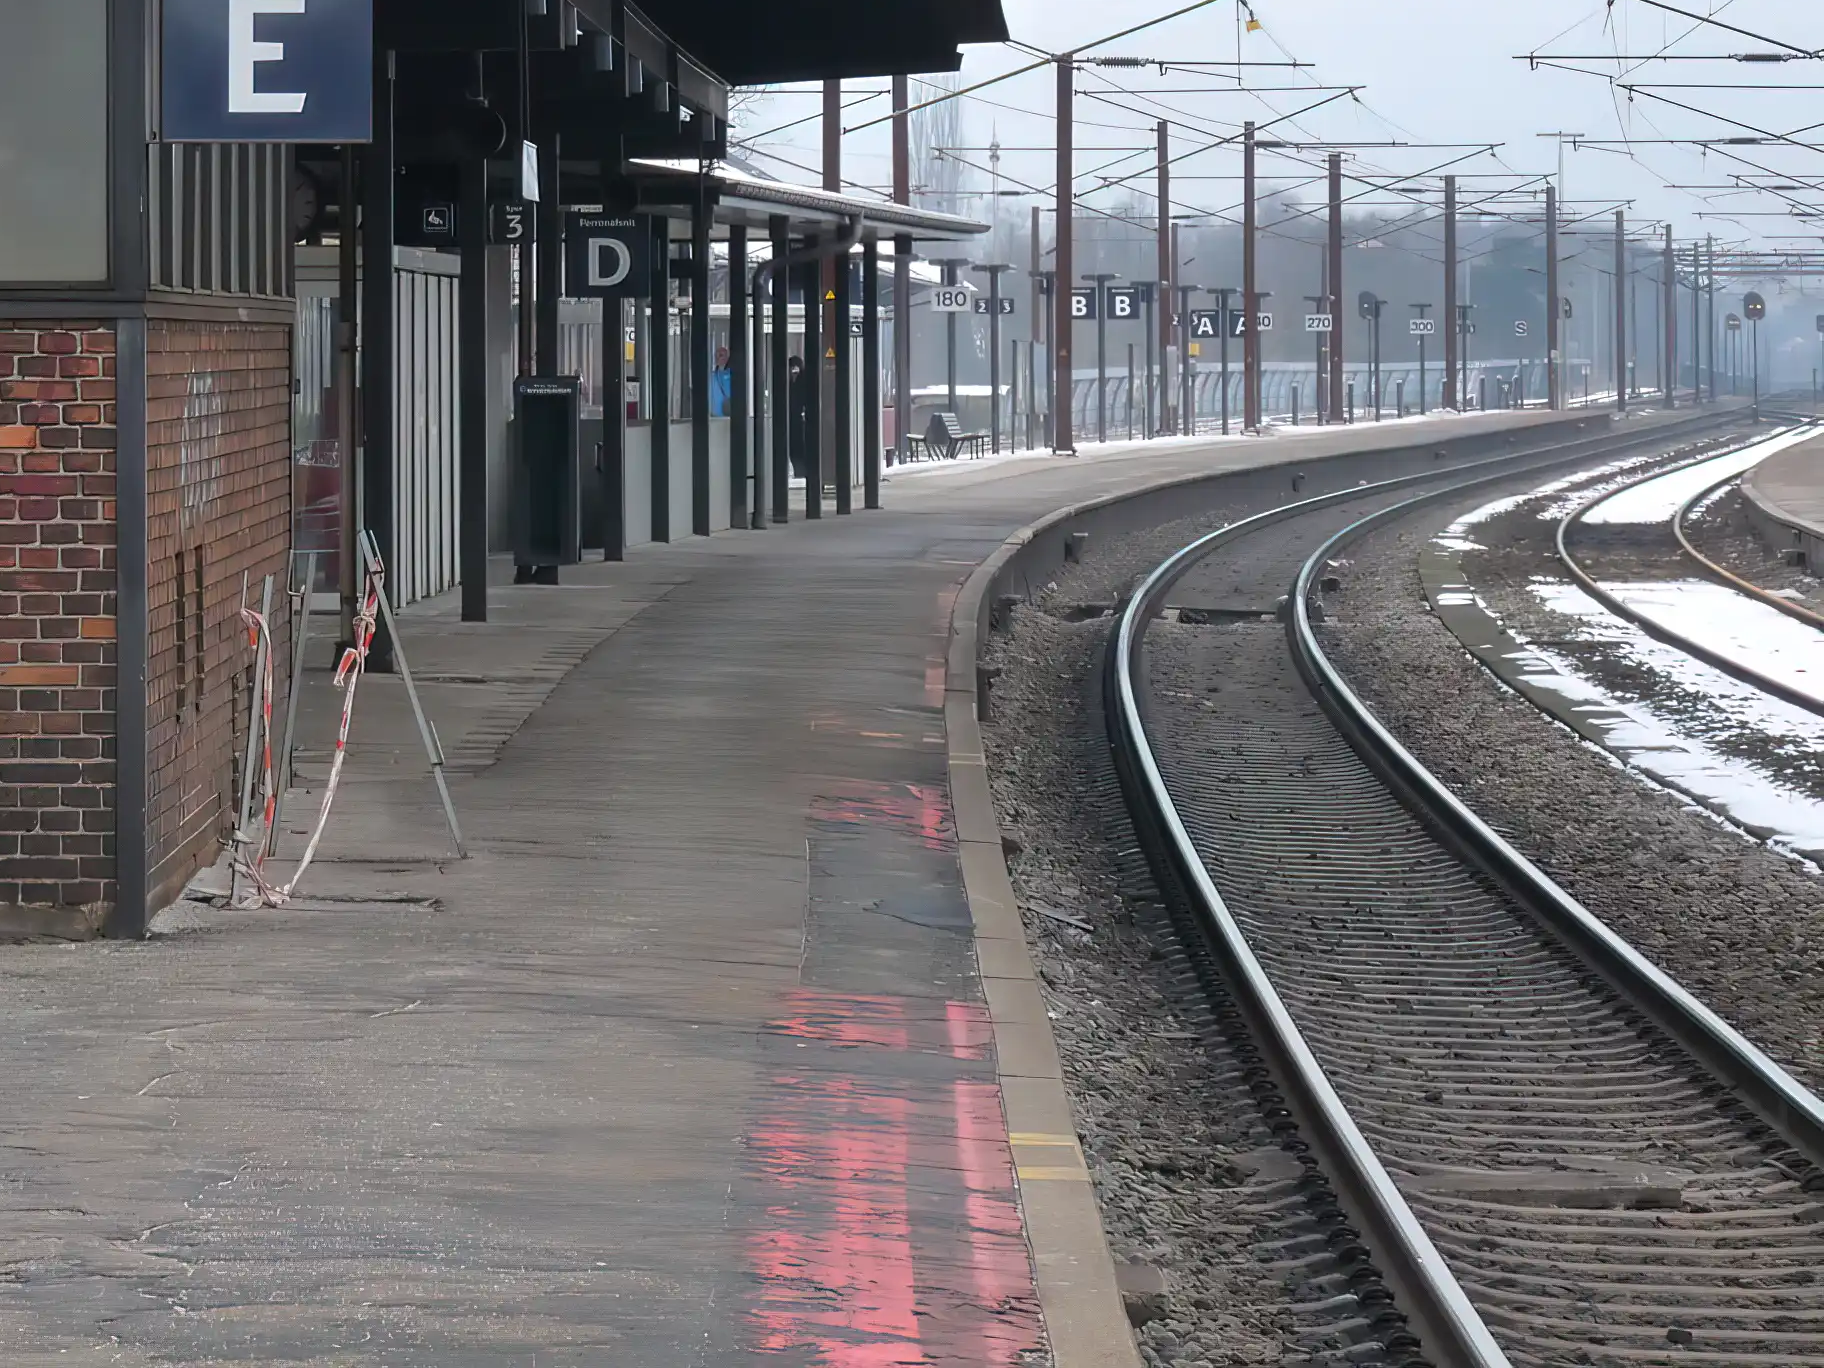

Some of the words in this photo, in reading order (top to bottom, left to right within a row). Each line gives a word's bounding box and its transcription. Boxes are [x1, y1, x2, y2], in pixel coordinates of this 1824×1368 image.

[506, 214, 523, 239] 3
[588, 237, 631, 286] D
[934, 291, 967, 307] 180
[978, 302, 987, 313] 2
[1071, 295, 1087, 317] B
[1115, 295, 1131, 317] B
[1197, 317, 1214, 335] A
[1307, 317, 1331, 329] 270
